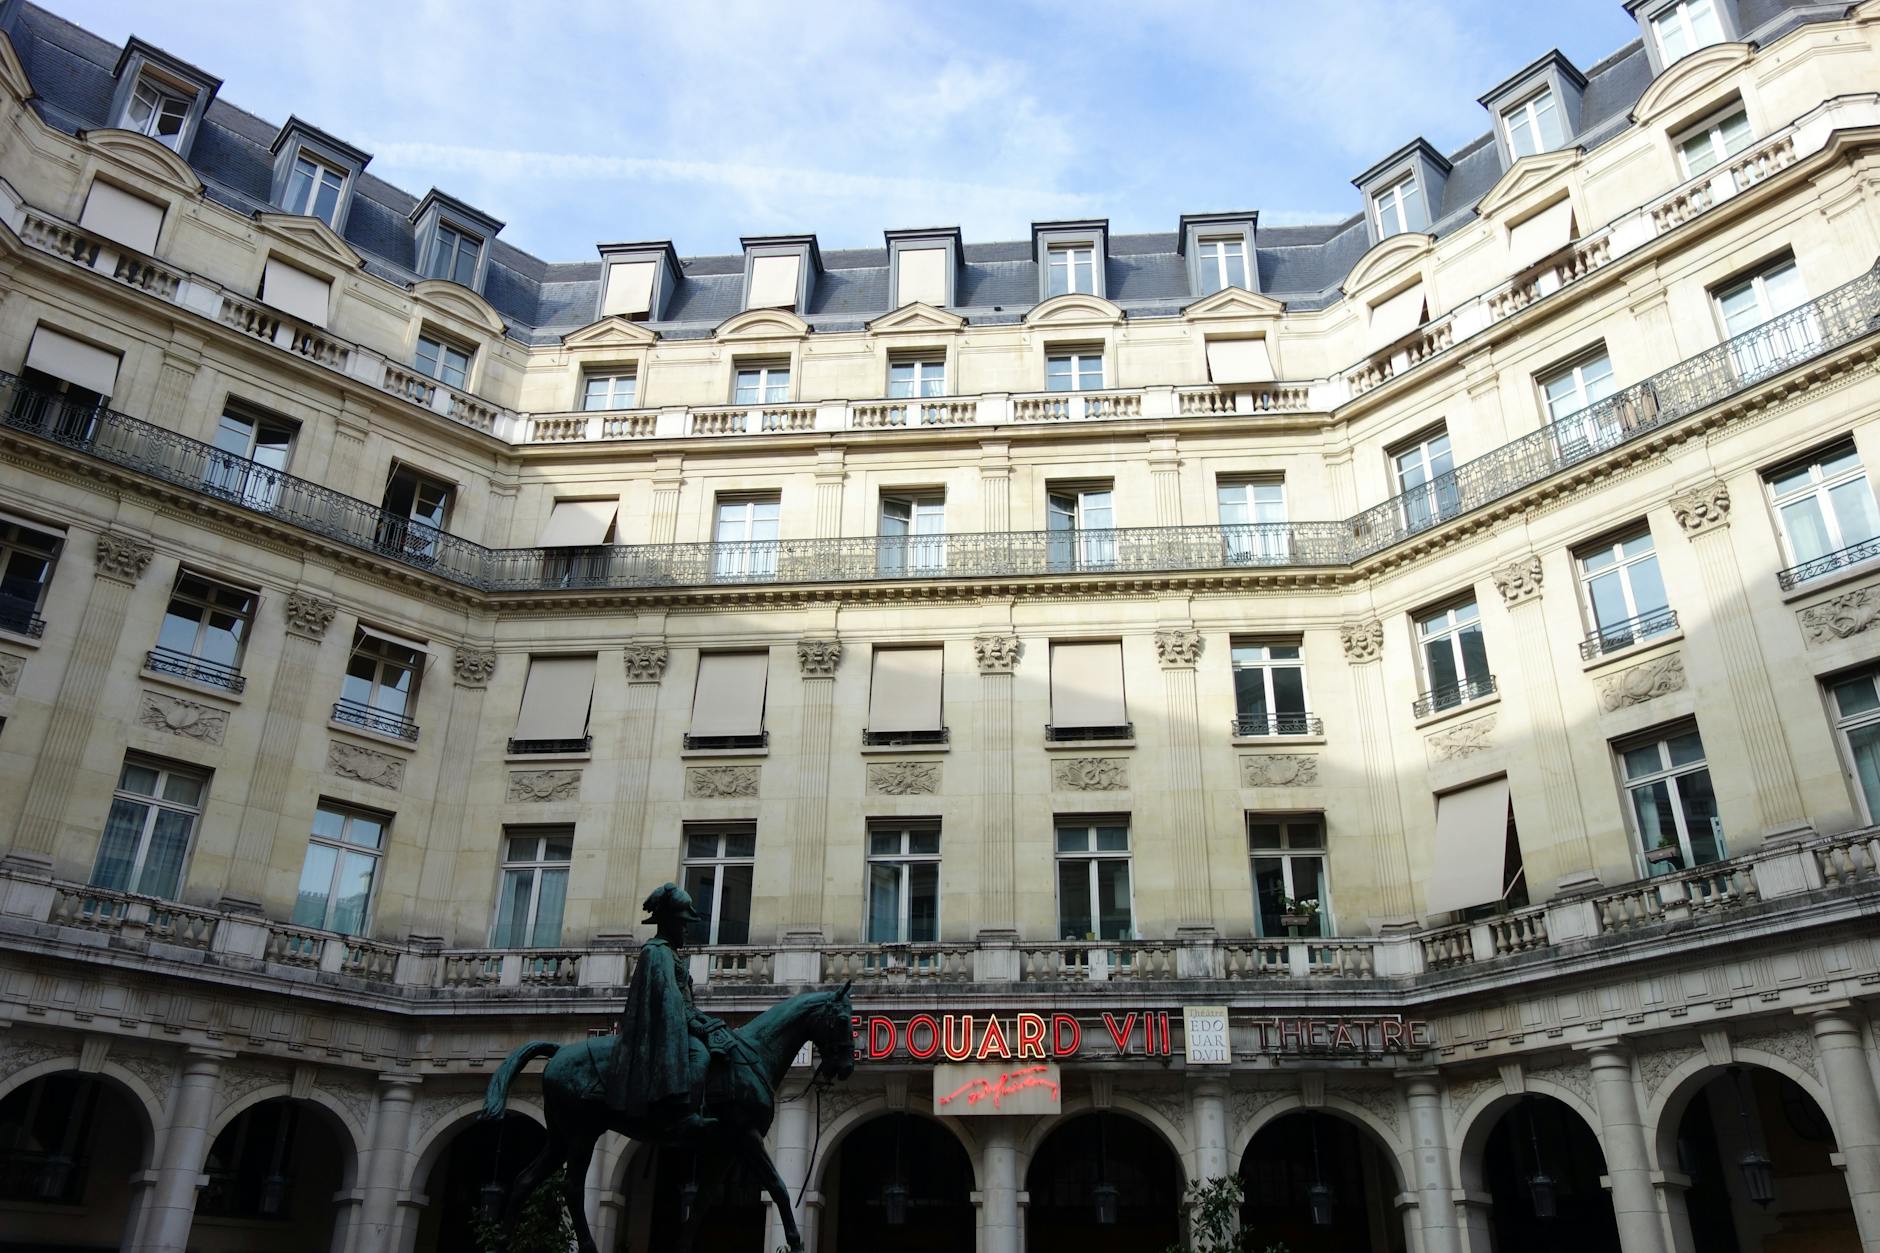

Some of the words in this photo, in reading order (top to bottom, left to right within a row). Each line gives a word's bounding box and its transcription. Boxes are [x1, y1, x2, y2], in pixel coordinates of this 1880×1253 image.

[1101, 1011, 1172, 1056] VII
[1190, 1019, 1224, 1032] EDO
[1251, 1017, 1431, 1051] THEATRE
[1191, 1035, 1225, 1047] UAR
